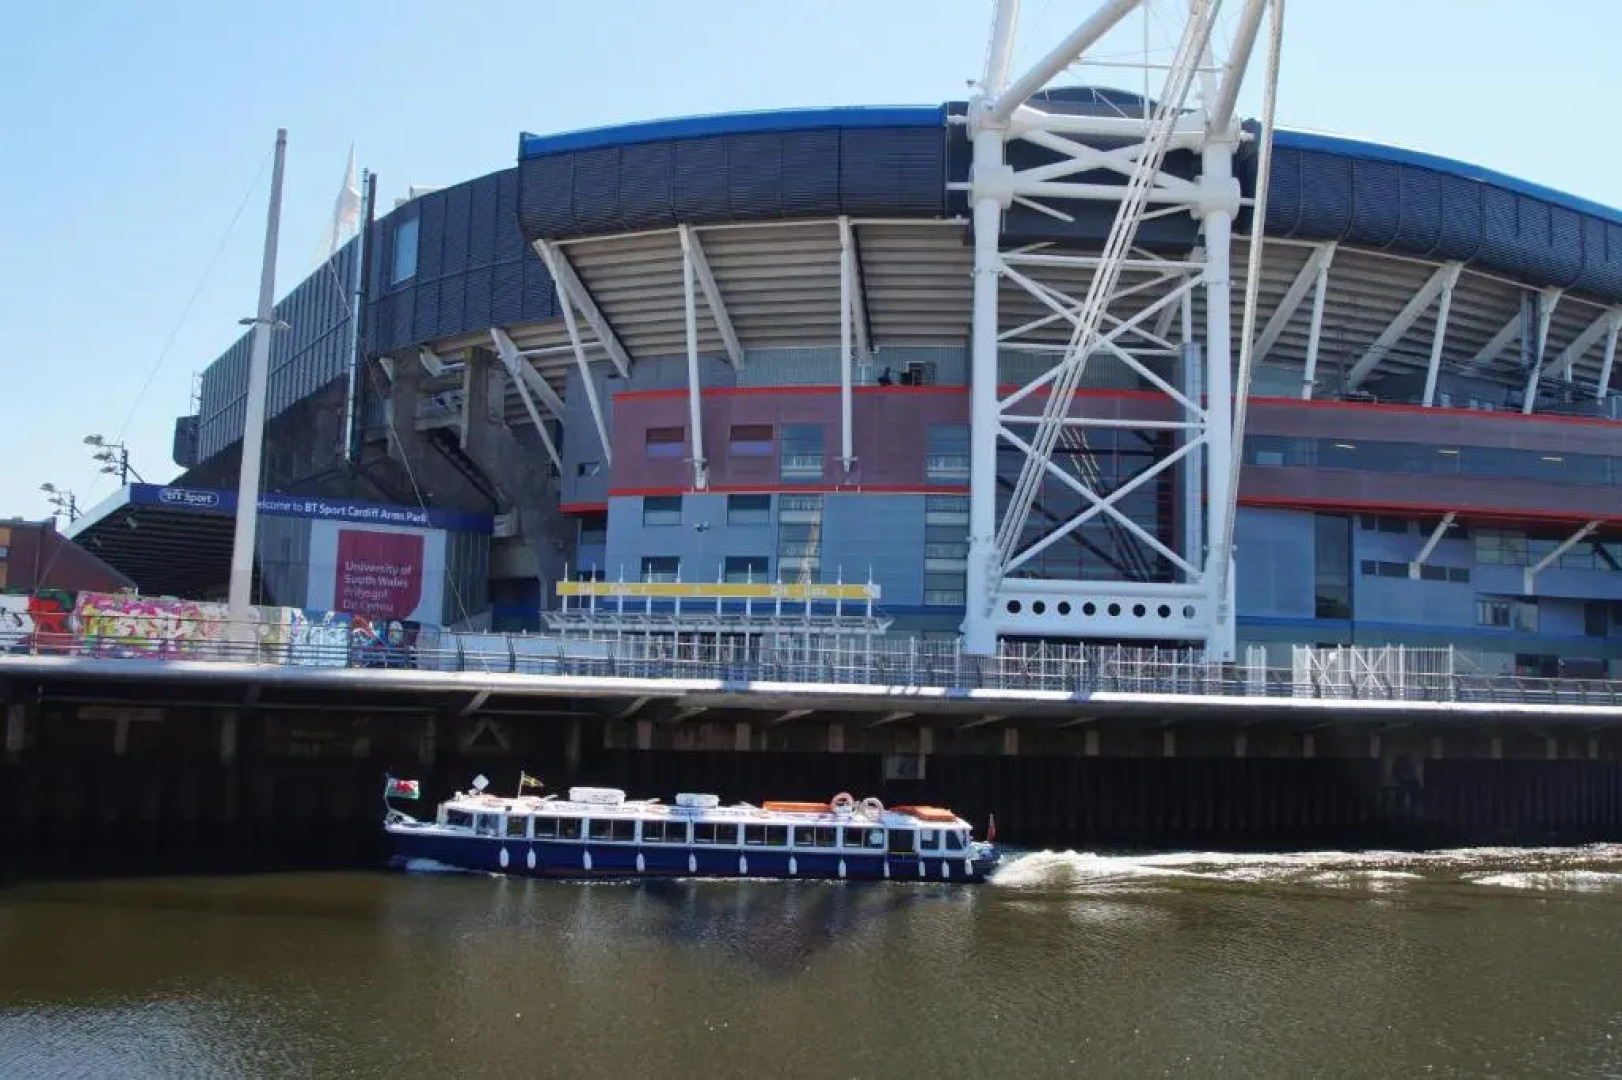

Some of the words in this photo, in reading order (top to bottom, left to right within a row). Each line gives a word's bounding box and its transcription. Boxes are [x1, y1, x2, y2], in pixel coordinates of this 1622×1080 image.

[184, 490, 213, 503] Sport
[255, 500, 291, 511] elcome
[293, 501, 303, 512] to
[305, 501, 318, 513] BT
[319, 502, 346, 516] Sport
[348, 506, 379, 518] Cardiff
[380, 509, 405, 520] Arms
[406, 510, 427, 522] Park
[345, 560, 399, 576] University
[401, 564, 412, 576] of
[344, 573, 376, 585] South
[378, 575, 408, 588] Wales
